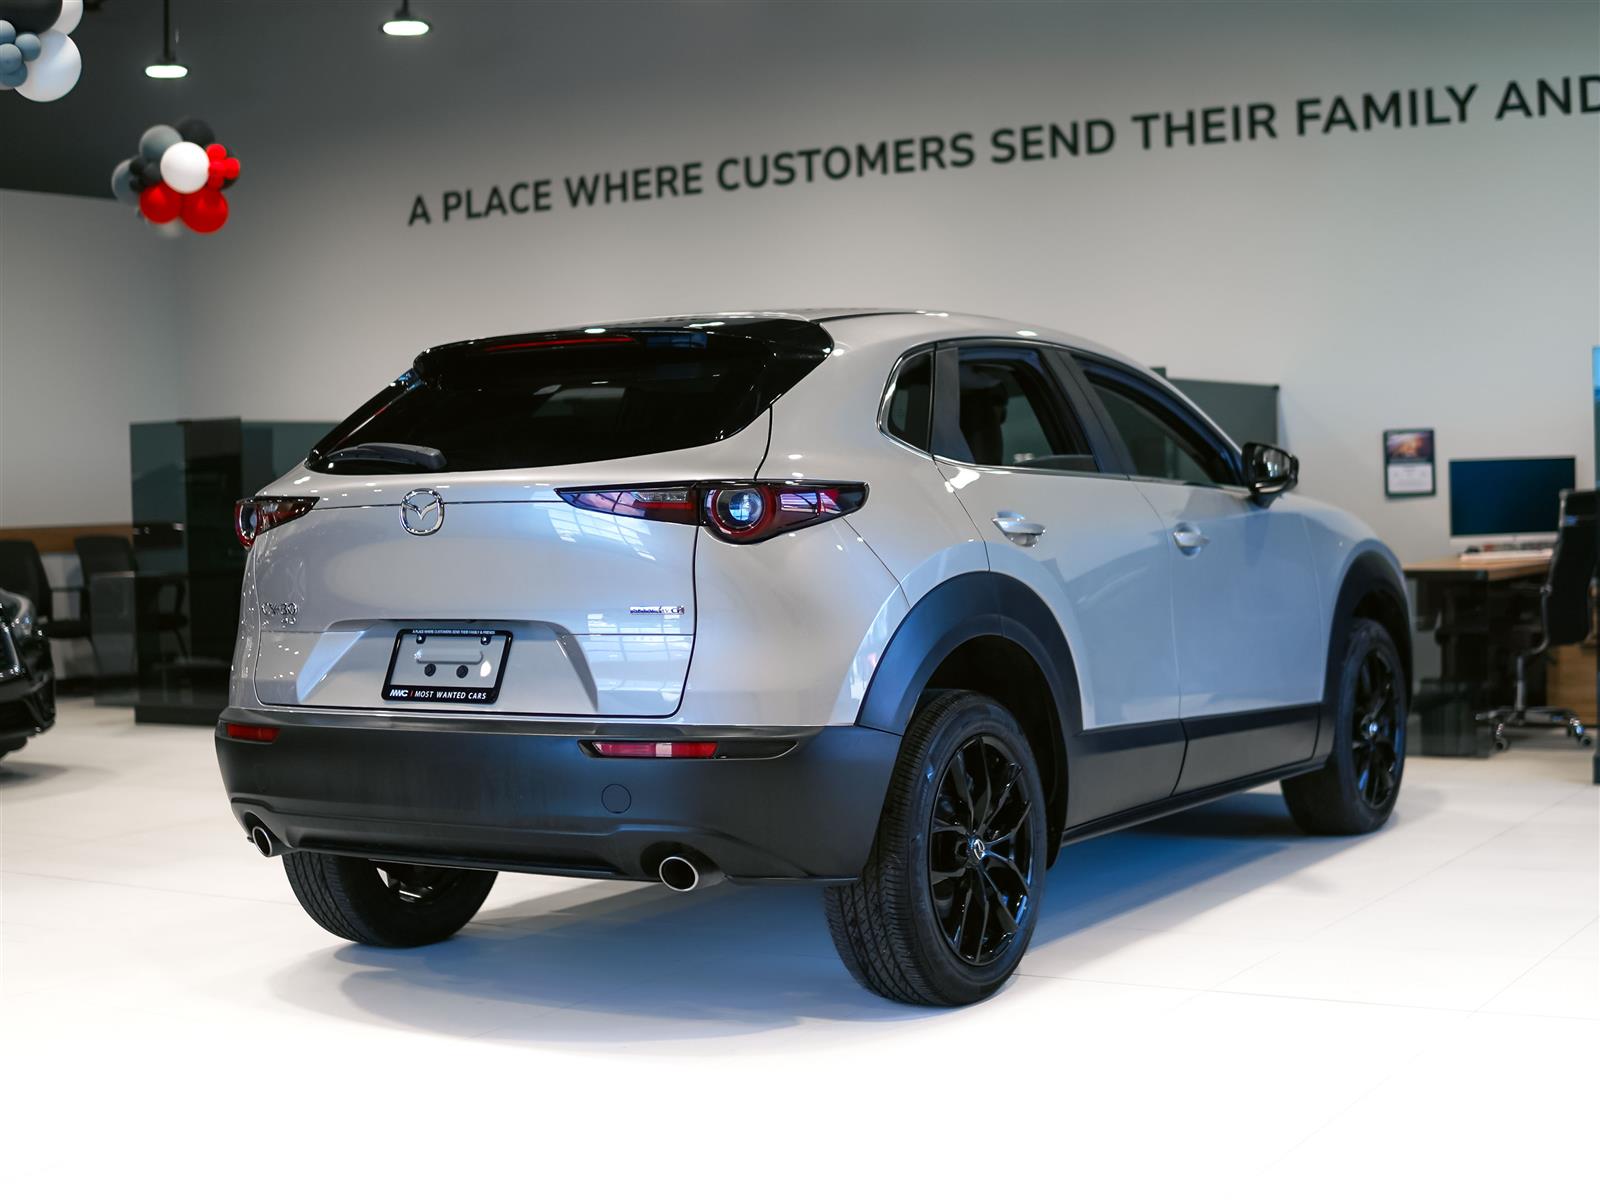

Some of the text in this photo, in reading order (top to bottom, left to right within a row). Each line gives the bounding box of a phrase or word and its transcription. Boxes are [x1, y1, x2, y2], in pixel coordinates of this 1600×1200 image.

[408, 195, 432, 227] A
[442, 179, 552, 223] PLACE
[564, 162, 703, 209] WHERE
[716, 132, 977, 192] CUSTOMERS
[990, 118, 1117, 165] SEND
[1131, 102, 1279, 151] THEIR
[1296, 83, 1479, 137] FAMILY
[414, 690, 434, 698] MOST
[436, 691, 466, 699] WANTED
[468, 692, 487, 700] CARS
